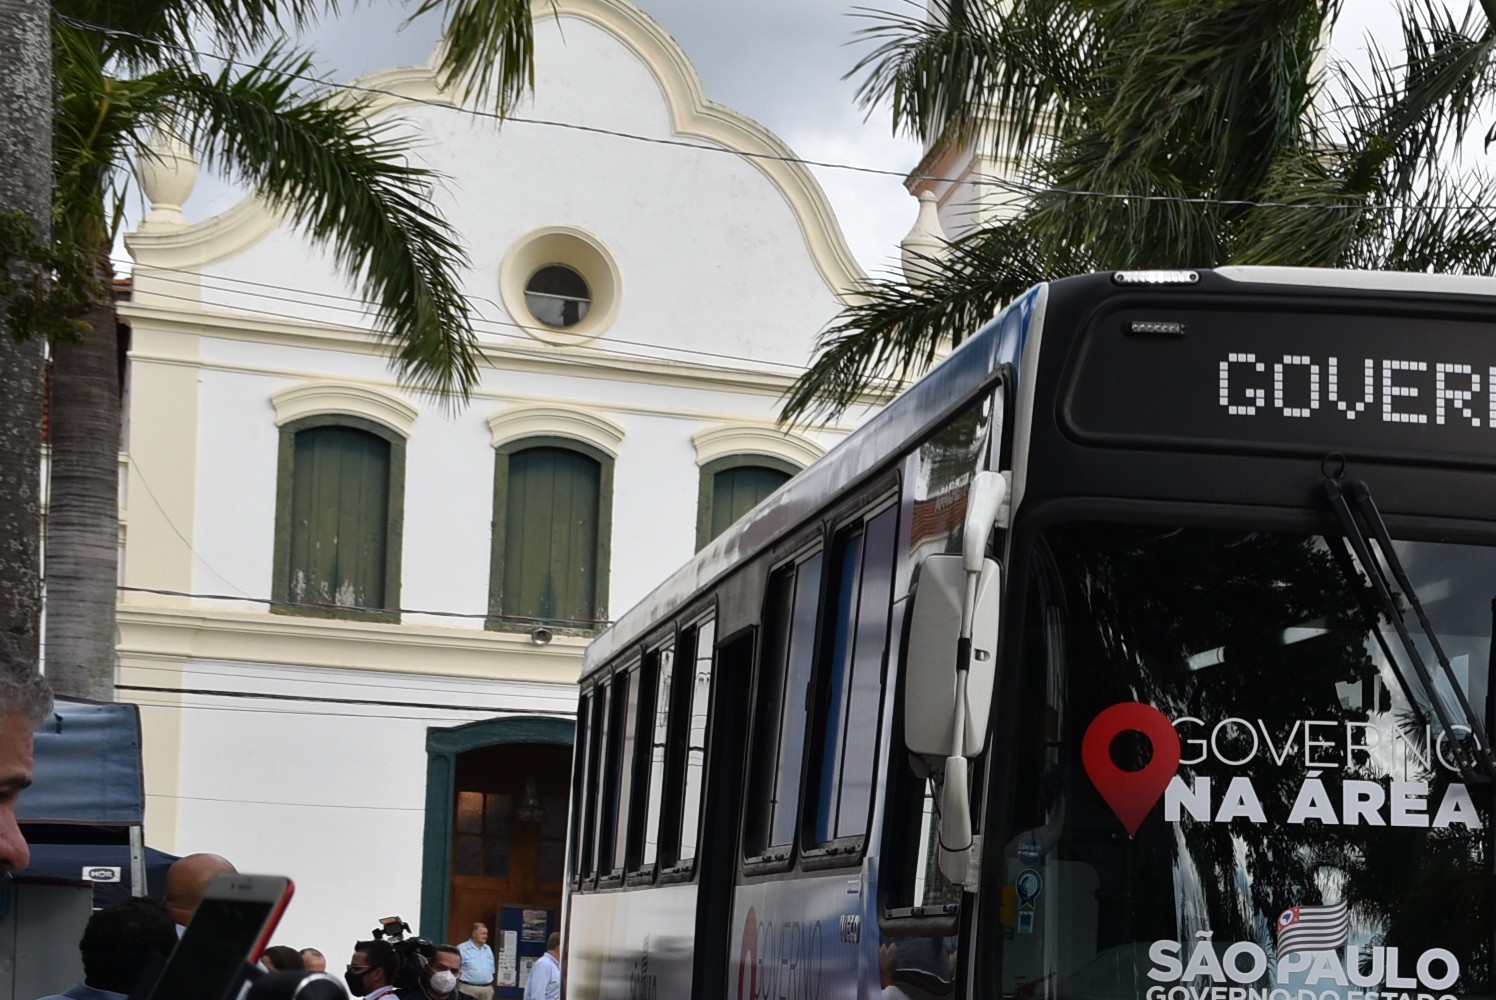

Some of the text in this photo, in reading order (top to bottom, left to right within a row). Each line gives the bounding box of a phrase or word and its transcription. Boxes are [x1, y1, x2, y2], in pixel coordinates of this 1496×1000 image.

[1172, 716, 1482, 772] GOVERNO
[1164, 770, 1483, 829] NA ÁREA
[1147, 930, 1460, 990] SÃO PAULO
